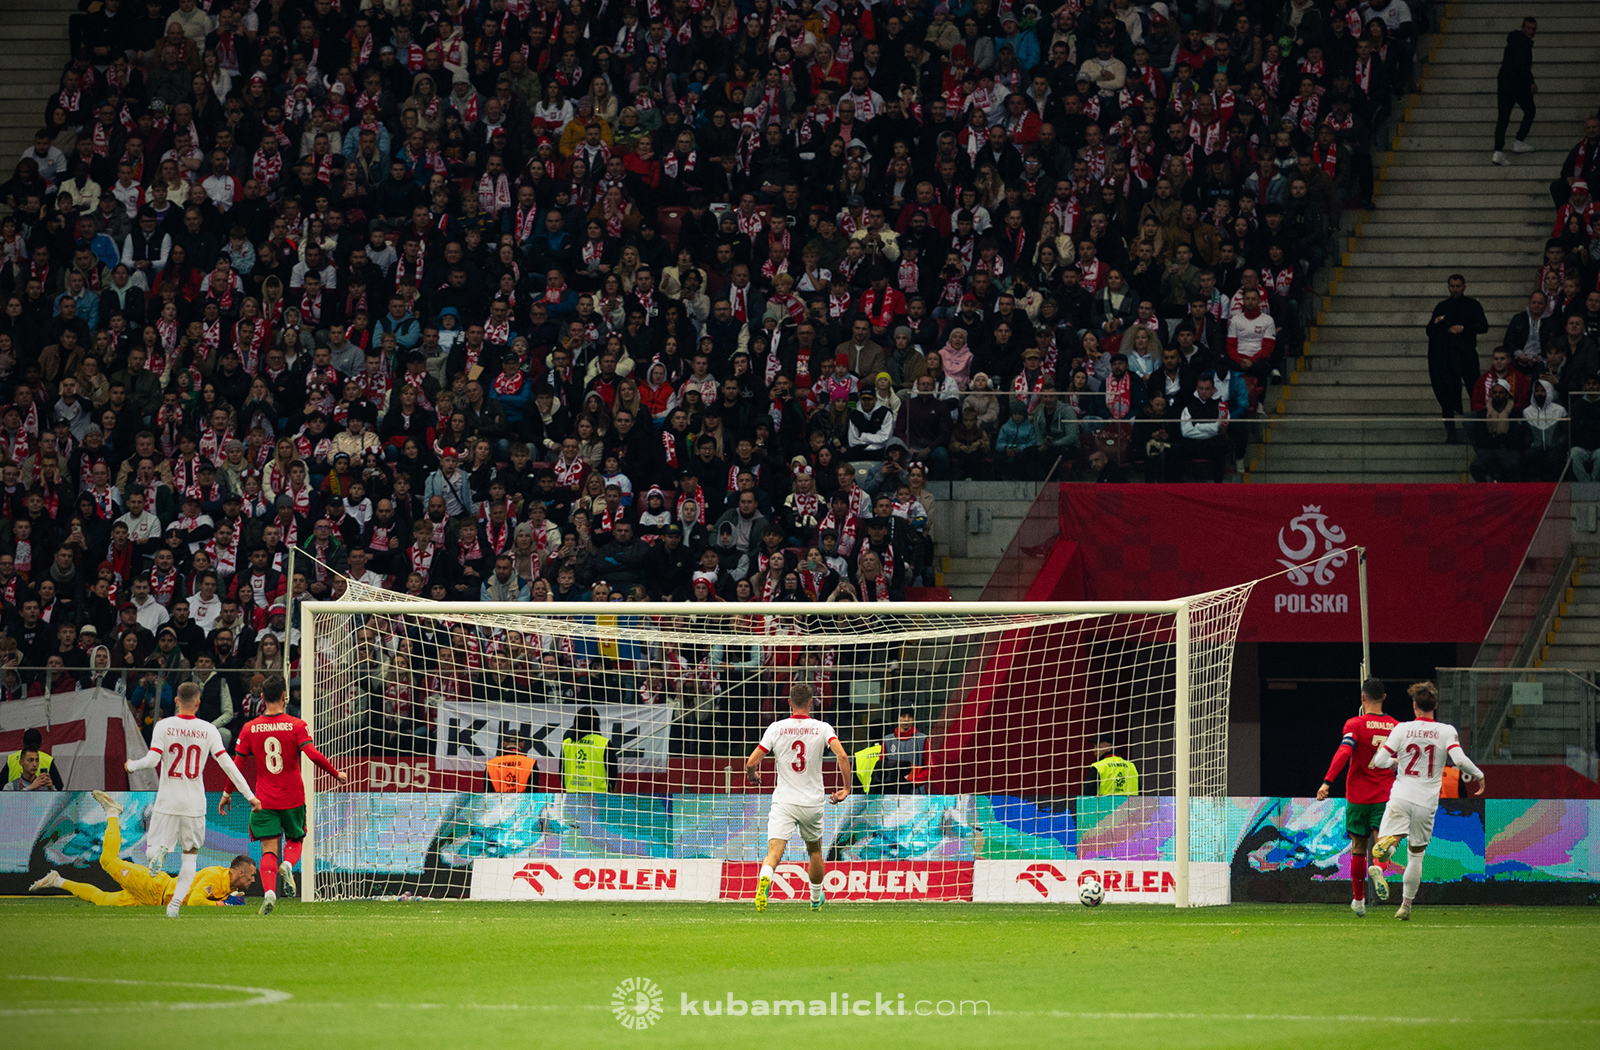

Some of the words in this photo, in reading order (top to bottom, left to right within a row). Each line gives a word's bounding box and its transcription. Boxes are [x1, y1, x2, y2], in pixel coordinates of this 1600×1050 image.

[1274, 593, 1348, 613] POLSKA
[166, 726, 208, 740] SZYMAŃSKI
[251, 721, 293, 733] B.FERNANDES
[779, 727, 819, 736] DAWIDOWICZ
[1406, 729, 1440, 740] ZALEWSKI
[168, 742, 202, 781] 20
[263, 736, 284, 774] 8
[791, 740, 806, 773] 3
[1404, 743, 1436, 778] 21
[370, 762, 431, 788] D05
[572, 868, 677, 890] ORLEN
[822, 870, 928, 893] ORLEN
